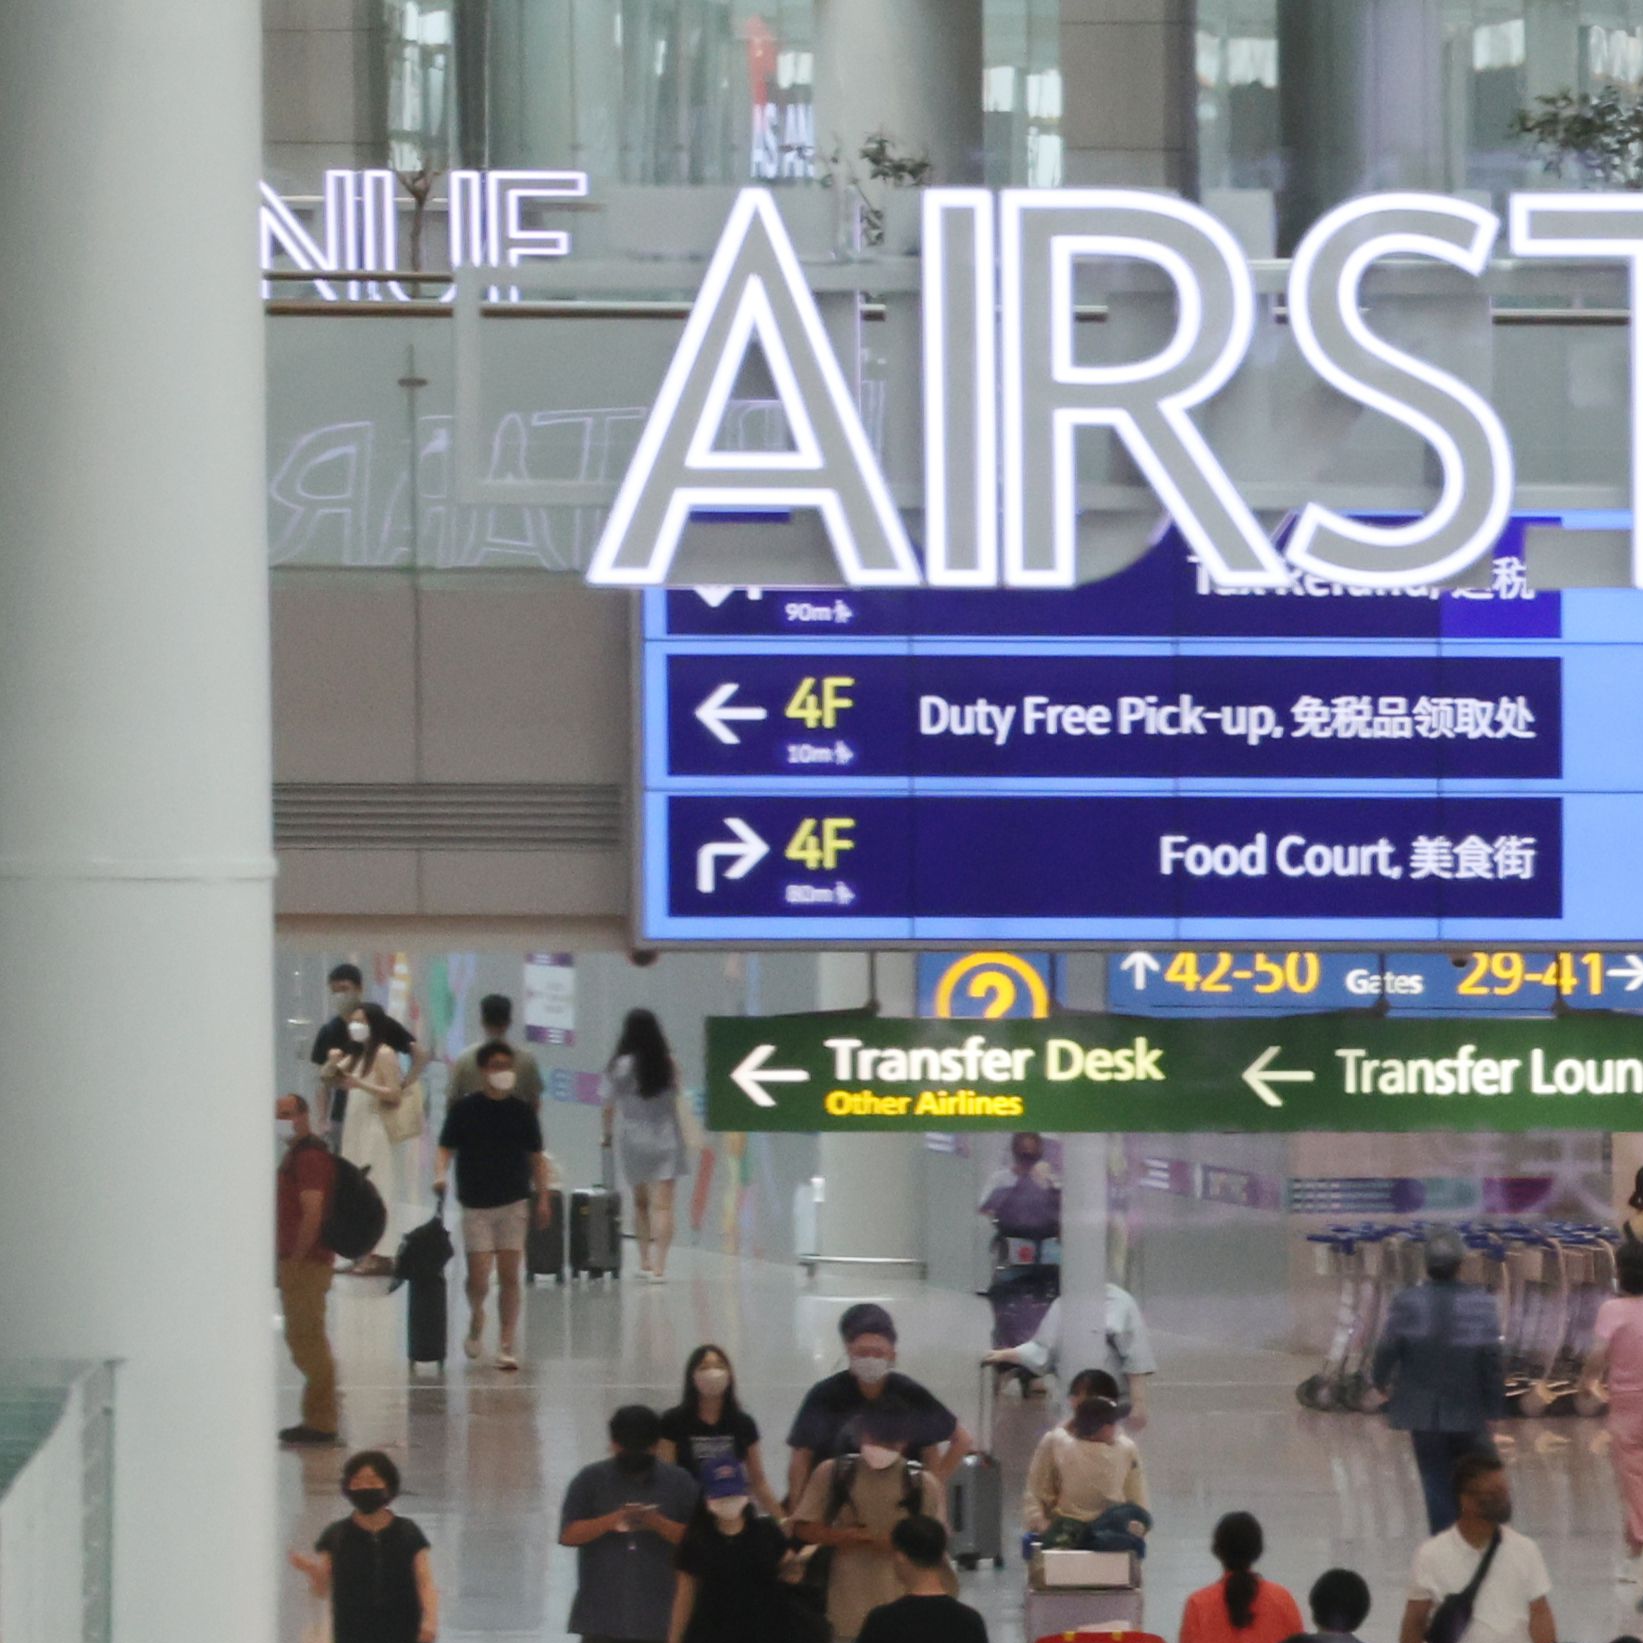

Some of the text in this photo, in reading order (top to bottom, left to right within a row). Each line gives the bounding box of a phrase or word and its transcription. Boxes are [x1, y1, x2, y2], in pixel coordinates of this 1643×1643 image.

[785, 603, 832, 623] 90m
[785, 677, 855, 728] 4F
[919, 696, 1015, 745] Duty
[1024, 696, 1111, 735] Free
[1117, 694, 1284, 746] Pick-up,
[785, 817, 856, 870] 4F
[1159, 832, 1537, 881] Food Court, 美食街
[1165, 952, 1603, 995] 42-50 Gates 29-41
[824, 1036, 1165, 1082] Transfer Desk
[1335, 1044, 1521, 1095] Transfer
[825, 1090, 1024, 1117] Other Airlines
